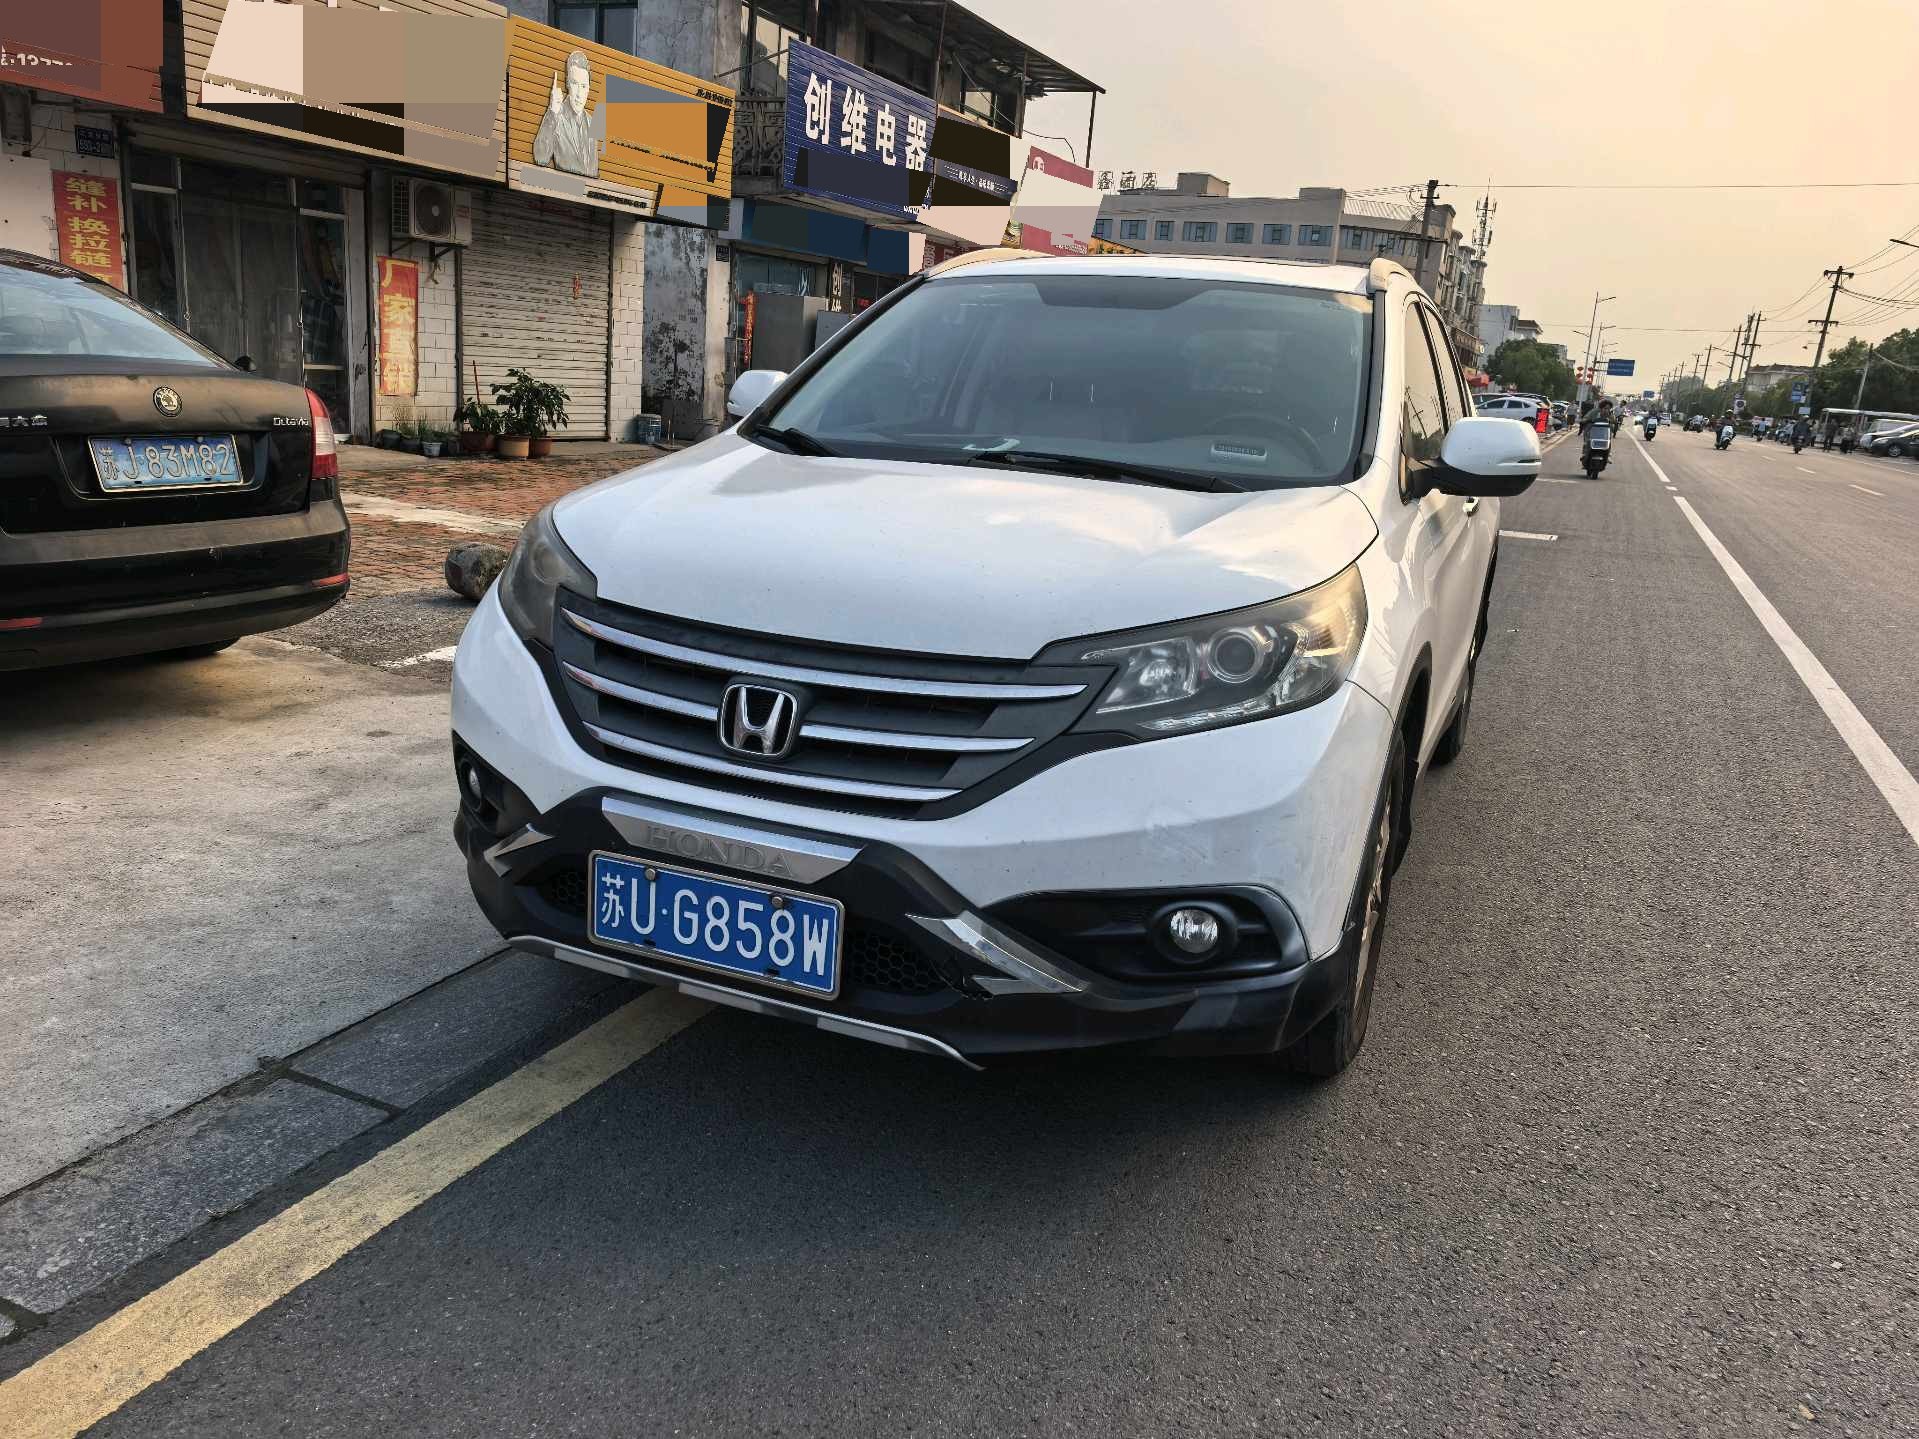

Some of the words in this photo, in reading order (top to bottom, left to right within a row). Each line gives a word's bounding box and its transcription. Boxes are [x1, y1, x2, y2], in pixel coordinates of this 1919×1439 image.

[803, 72, 928, 172] 创维电器
[645, 826, 796, 877] HONDA
